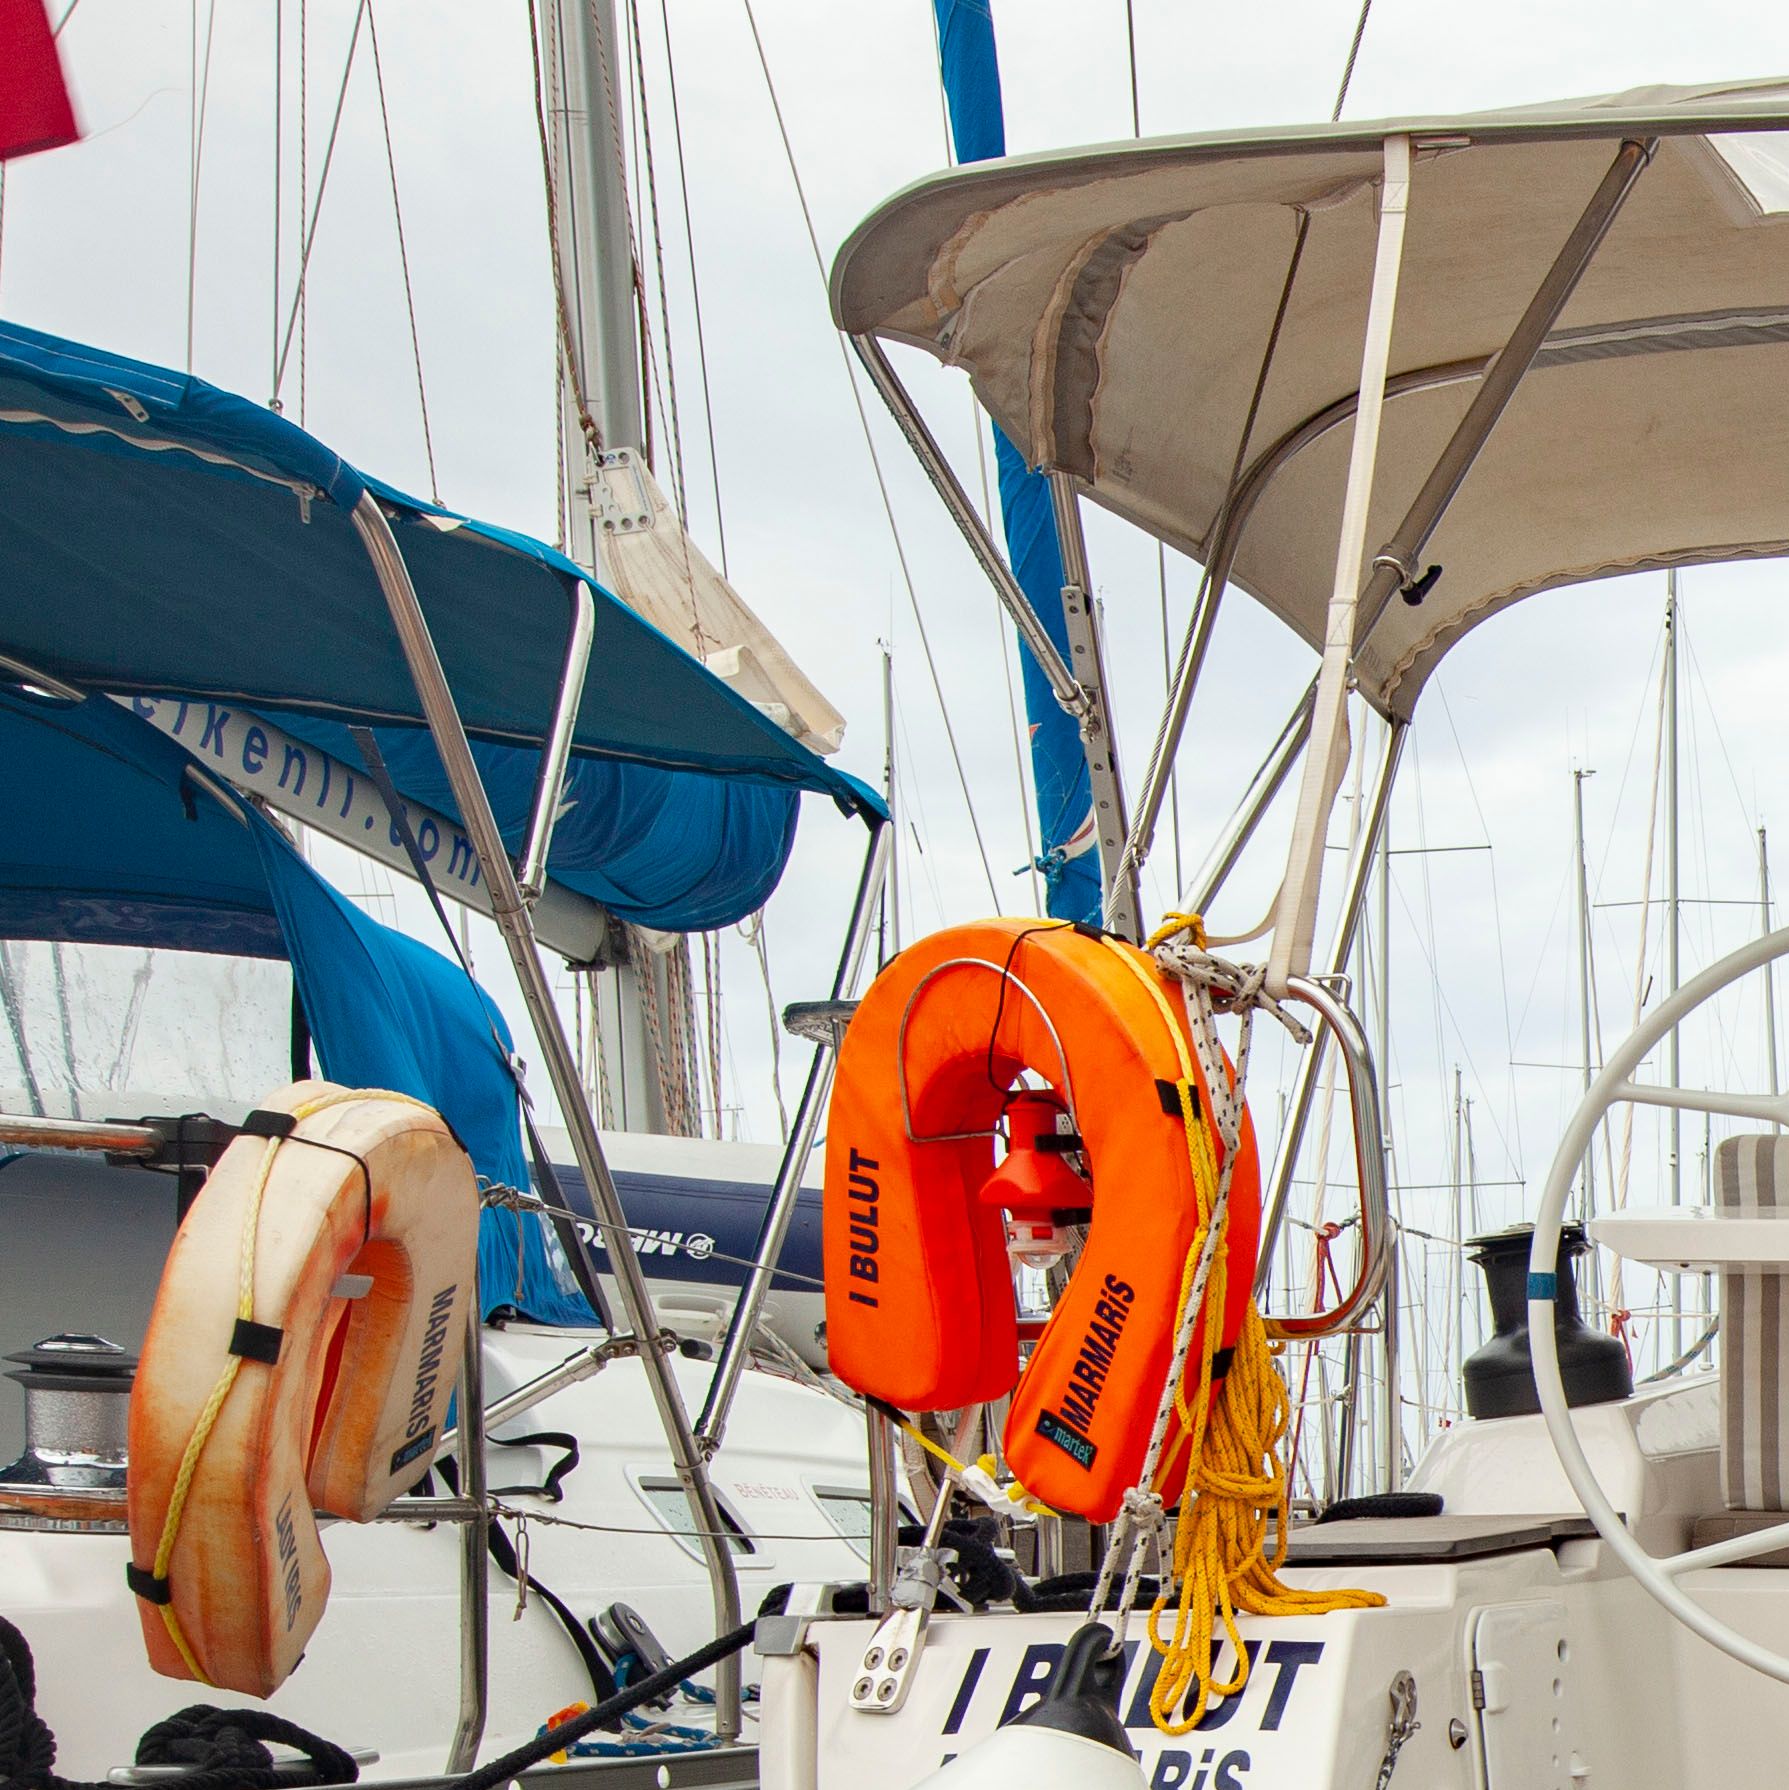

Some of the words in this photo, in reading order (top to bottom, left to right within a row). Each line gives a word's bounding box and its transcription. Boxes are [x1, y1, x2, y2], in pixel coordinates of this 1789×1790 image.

[849, 1147, 880, 1284] BULUT
[849, 1294, 879, 1308] I
[941, 1648, 991, 1736] I
[996, 1640, 1325, 1731] BLUT
